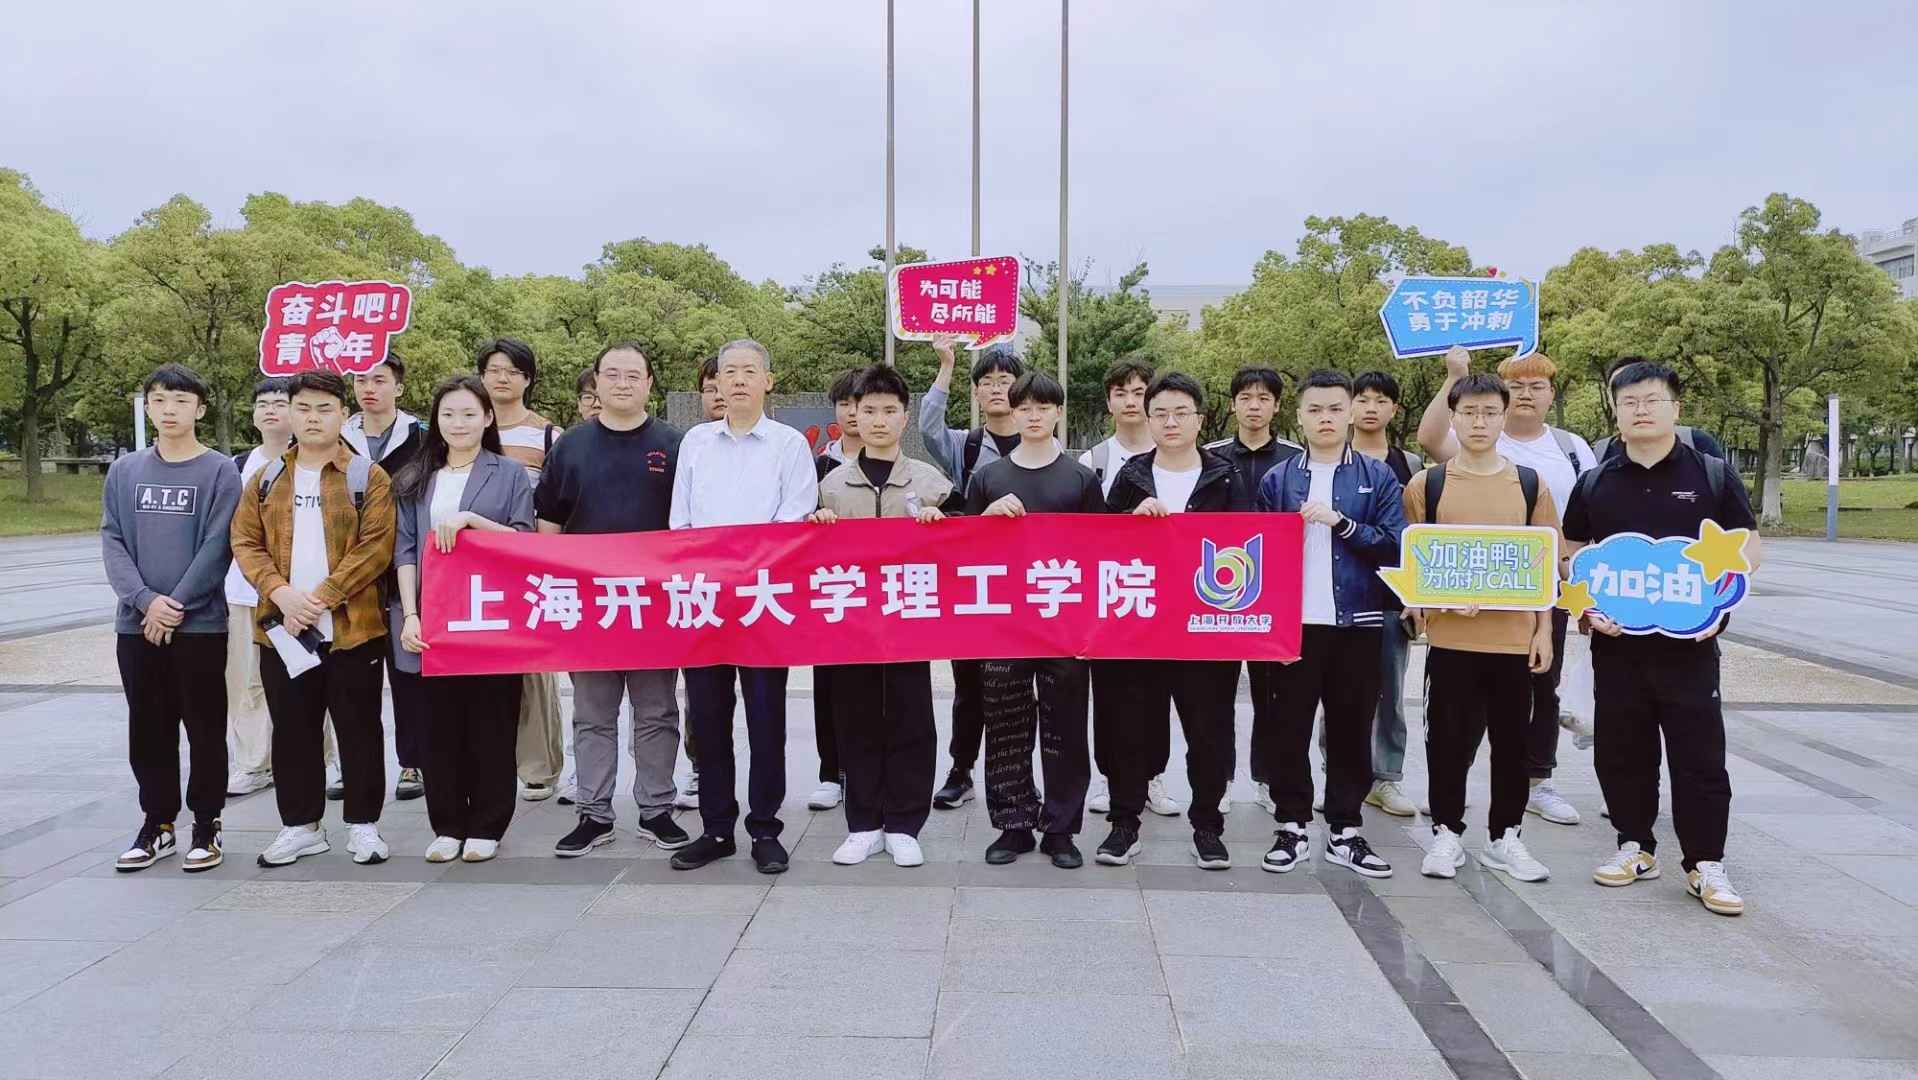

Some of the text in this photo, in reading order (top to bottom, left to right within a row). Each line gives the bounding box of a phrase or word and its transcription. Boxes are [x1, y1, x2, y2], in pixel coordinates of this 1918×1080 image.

[919, 279, 982, 300] 为可能
[1400, 289, 1520, 311] 不负韶华
[281, 292, 401, 326] 奋斗吧!
[930, 302, 997, 325] 尽所能
[1408, 310, 1514, 332] 勇于冲刺
[1429, 539, 1531, 571] 加油鸭!
[1423, 567, 1538, 592] 为你打CALL
[1589, 561, 1703, 605] 加油
[446, 558, 1157, 632] 上海开放大学理工学院
